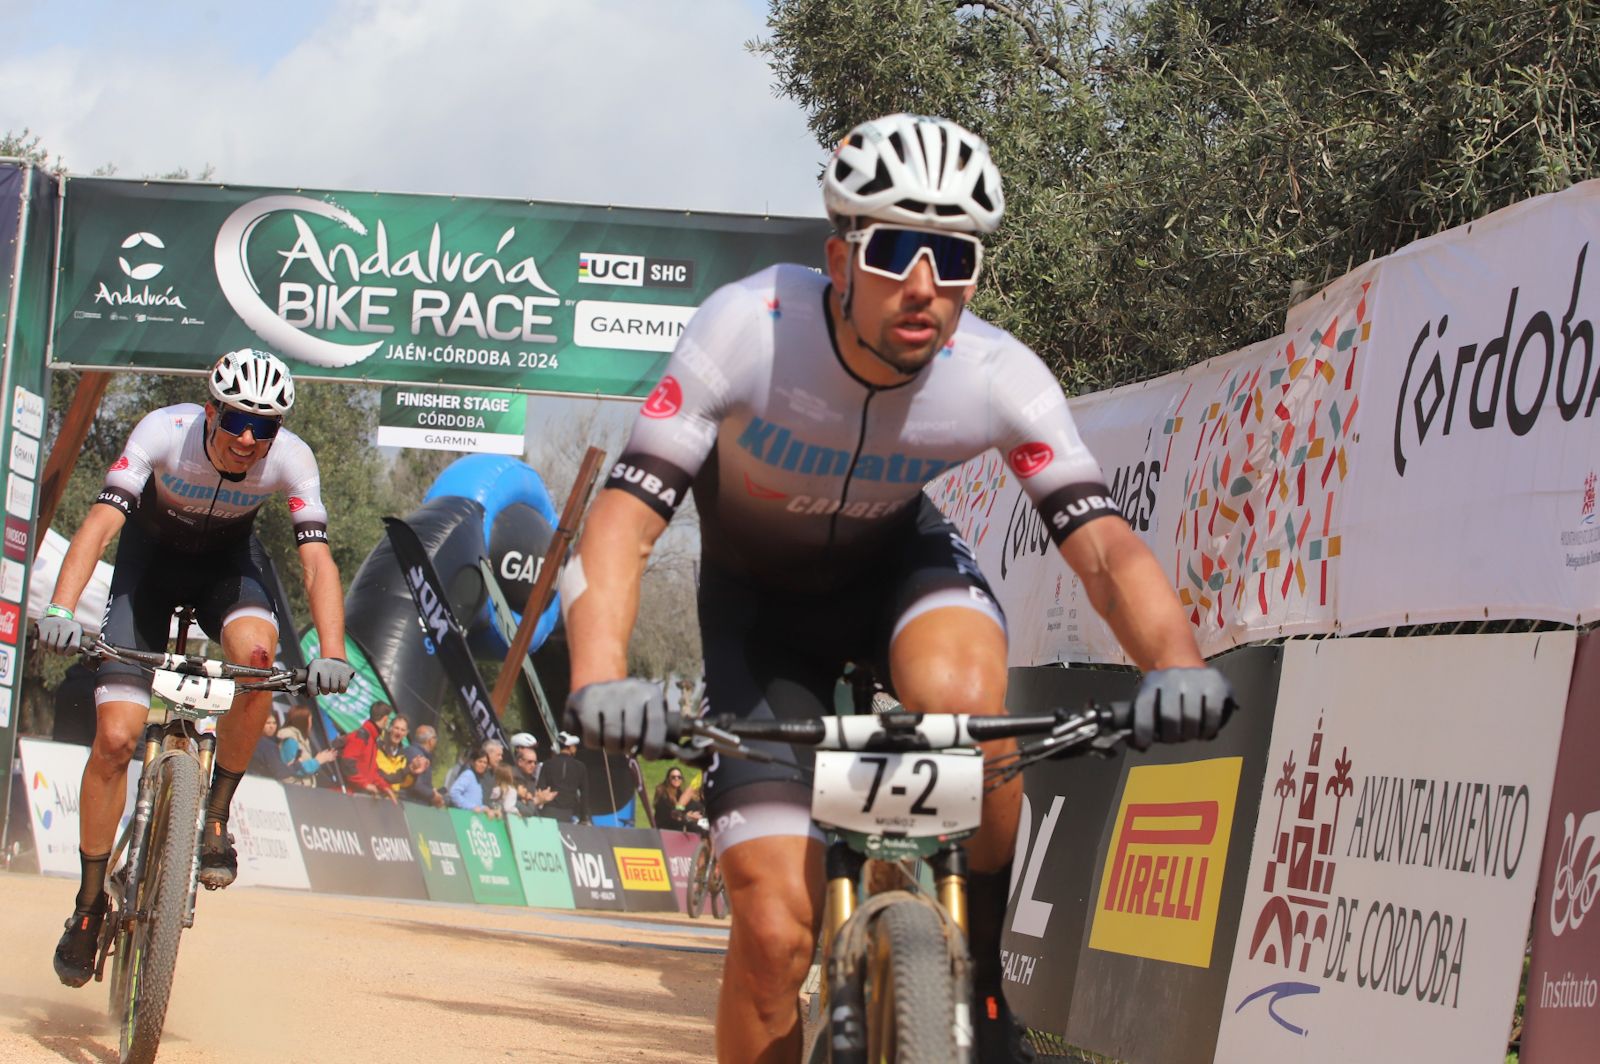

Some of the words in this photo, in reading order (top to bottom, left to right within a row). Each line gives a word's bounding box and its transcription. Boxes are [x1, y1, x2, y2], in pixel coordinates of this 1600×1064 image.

[277, 213, 560, 296] Andalucía
[589, 256, 639, 281] UCI
[650, 263, 686, 283] SHC
[94, 282, 188, 309] Andalucía
[277, 281, 397, 335] BIKE
[411, 289, 560, 344] RACE
[517, 352, 559, 370] 2024
[396, 391, 461, 410] FINISHER
[463, 397, 510, 412] STAGE
[418, 411, 485, 429] CÓRDOBA
[424, 434, 478, 446] GARMIN
[859, 756, 939, 816] 7-2
[300, 824, 363, 857] GARMIN
[1347, 775, 1530, 880] AYUNTAMIENTO
[370, 836, 414, 862] GARMIN
[1103, 800, 1219, 922] PIRELLI
[571, 852, 614, 889] NDL
[621, 856, 664, 882] PIRELLI
[1323, 896, 1359, 983] DE
[1356, 900, 1467, 1009] CORDOBA
[1540, 971, 1599, 1009] Instituto
